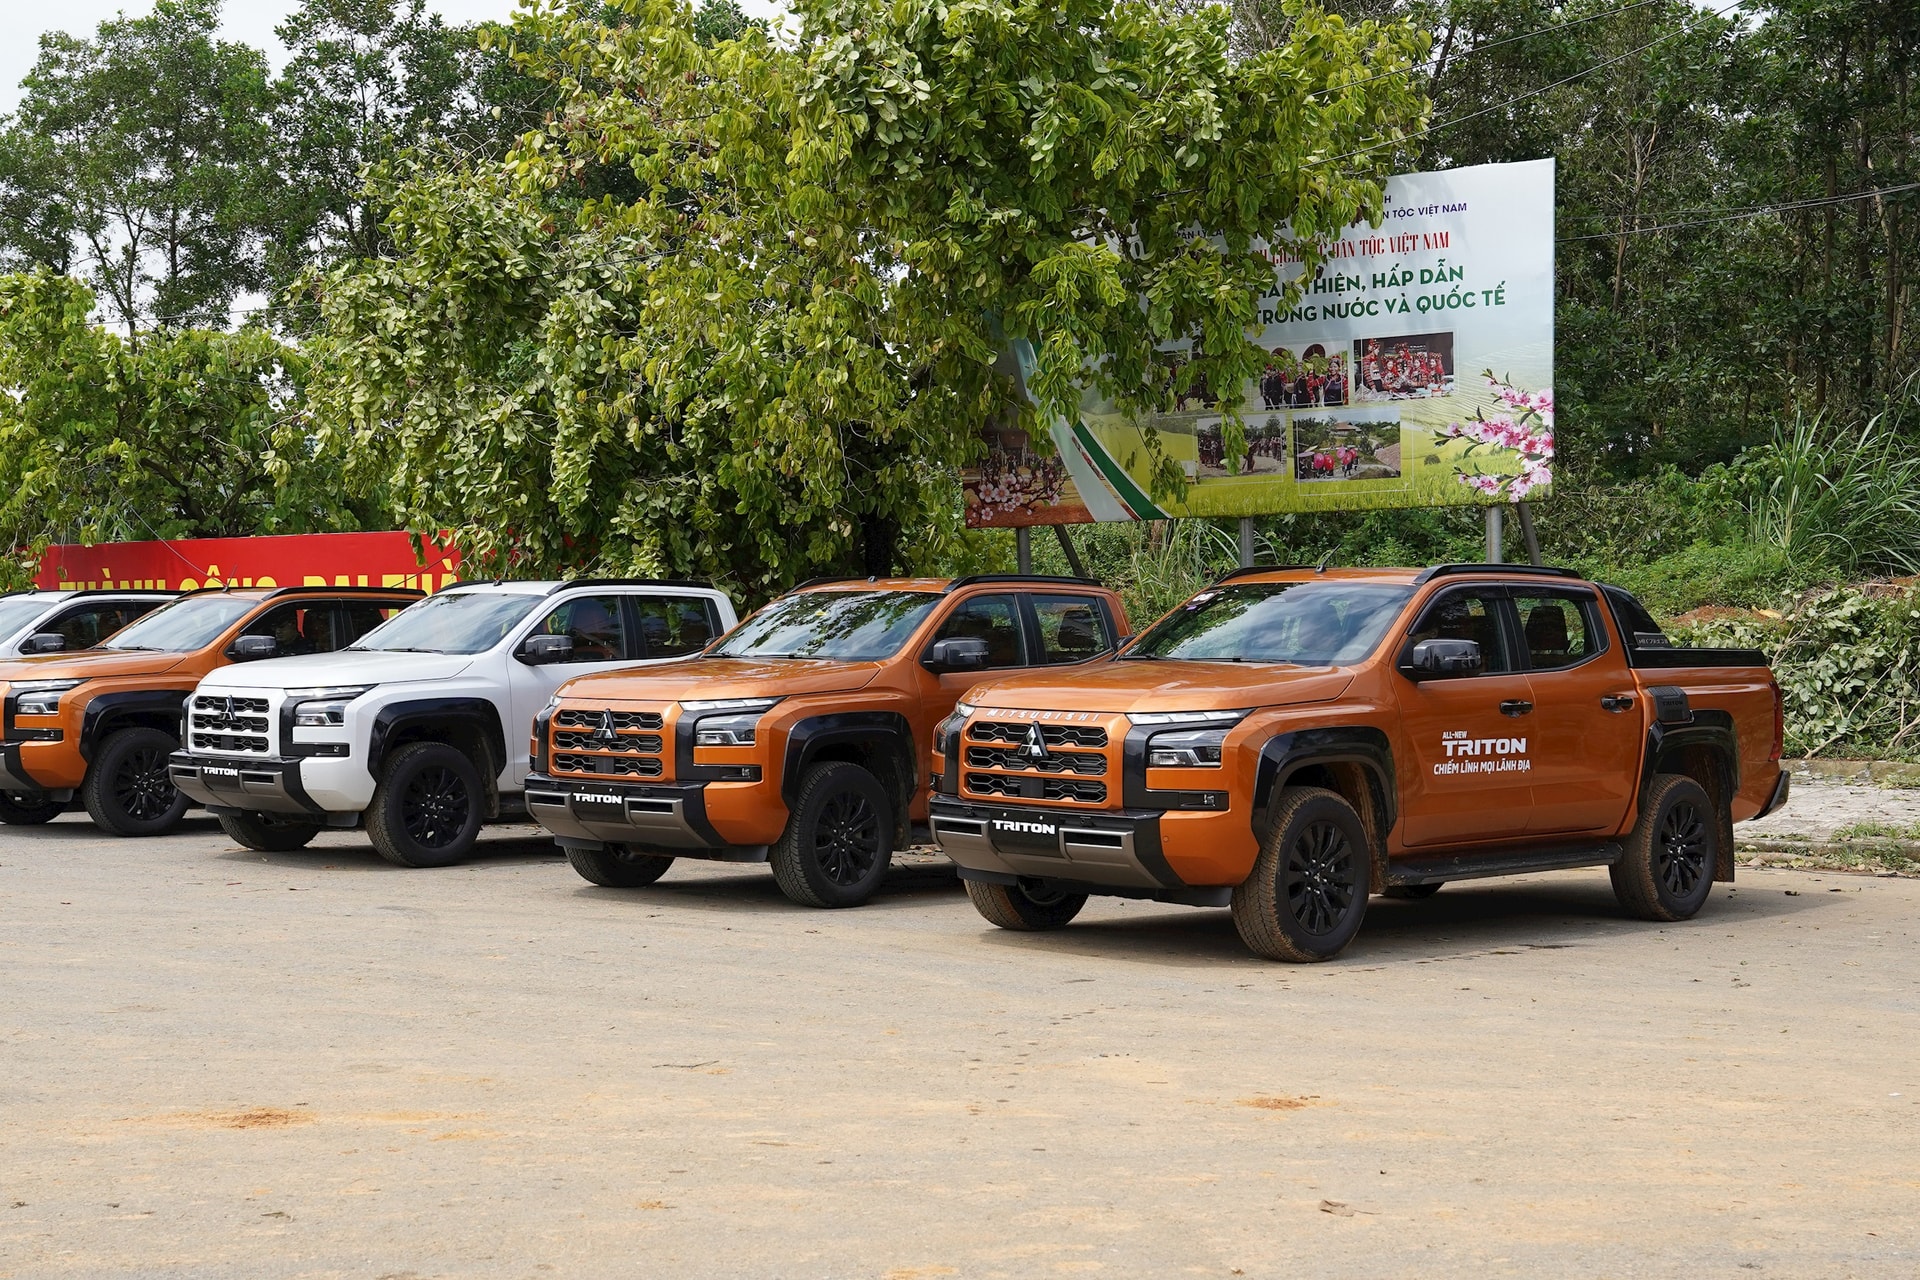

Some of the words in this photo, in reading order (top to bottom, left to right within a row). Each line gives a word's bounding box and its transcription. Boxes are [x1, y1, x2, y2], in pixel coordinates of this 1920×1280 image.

[1392, 207, 1415, 220] TỘC
[1418, 204, 1439, 217] VIỆT
[1442, 202, 1467, 213] NAM
[1360, 235, 1384, 258] TỘC
[1389, 232, 1419, 255] VIỆT
[1423, 231, 1449, 250] NAM
[1372, 263, 1414, 289] HẤP
[1420, 258, 1464, 285] DẪN
[1323, 297, 1379, 320] NƯỚC
[1384, 292, 1411, 314] VÀ
[1416, 284, 1476, 314] QUỐC
[1481, 280, 1506, 306] TẾ
[986, 709, 1100, 721] MITSUBISHI
[1442, 730, 1468, 740] ALL-NEW
[1442, 738, 1527, 757] TRITON
[202, 766, 238, 776] TRITON
[1433, 759, 1459, 775] CHIẾM
[1480, 760, 1495, 774] MỌI
[1496, 758, 1517, 772] LÃNH
[1517, 759, 1531, 773] ĐỊA
[573, 792, 622, 804] TRITON
[992, 819, 1056, 835] TRITON
